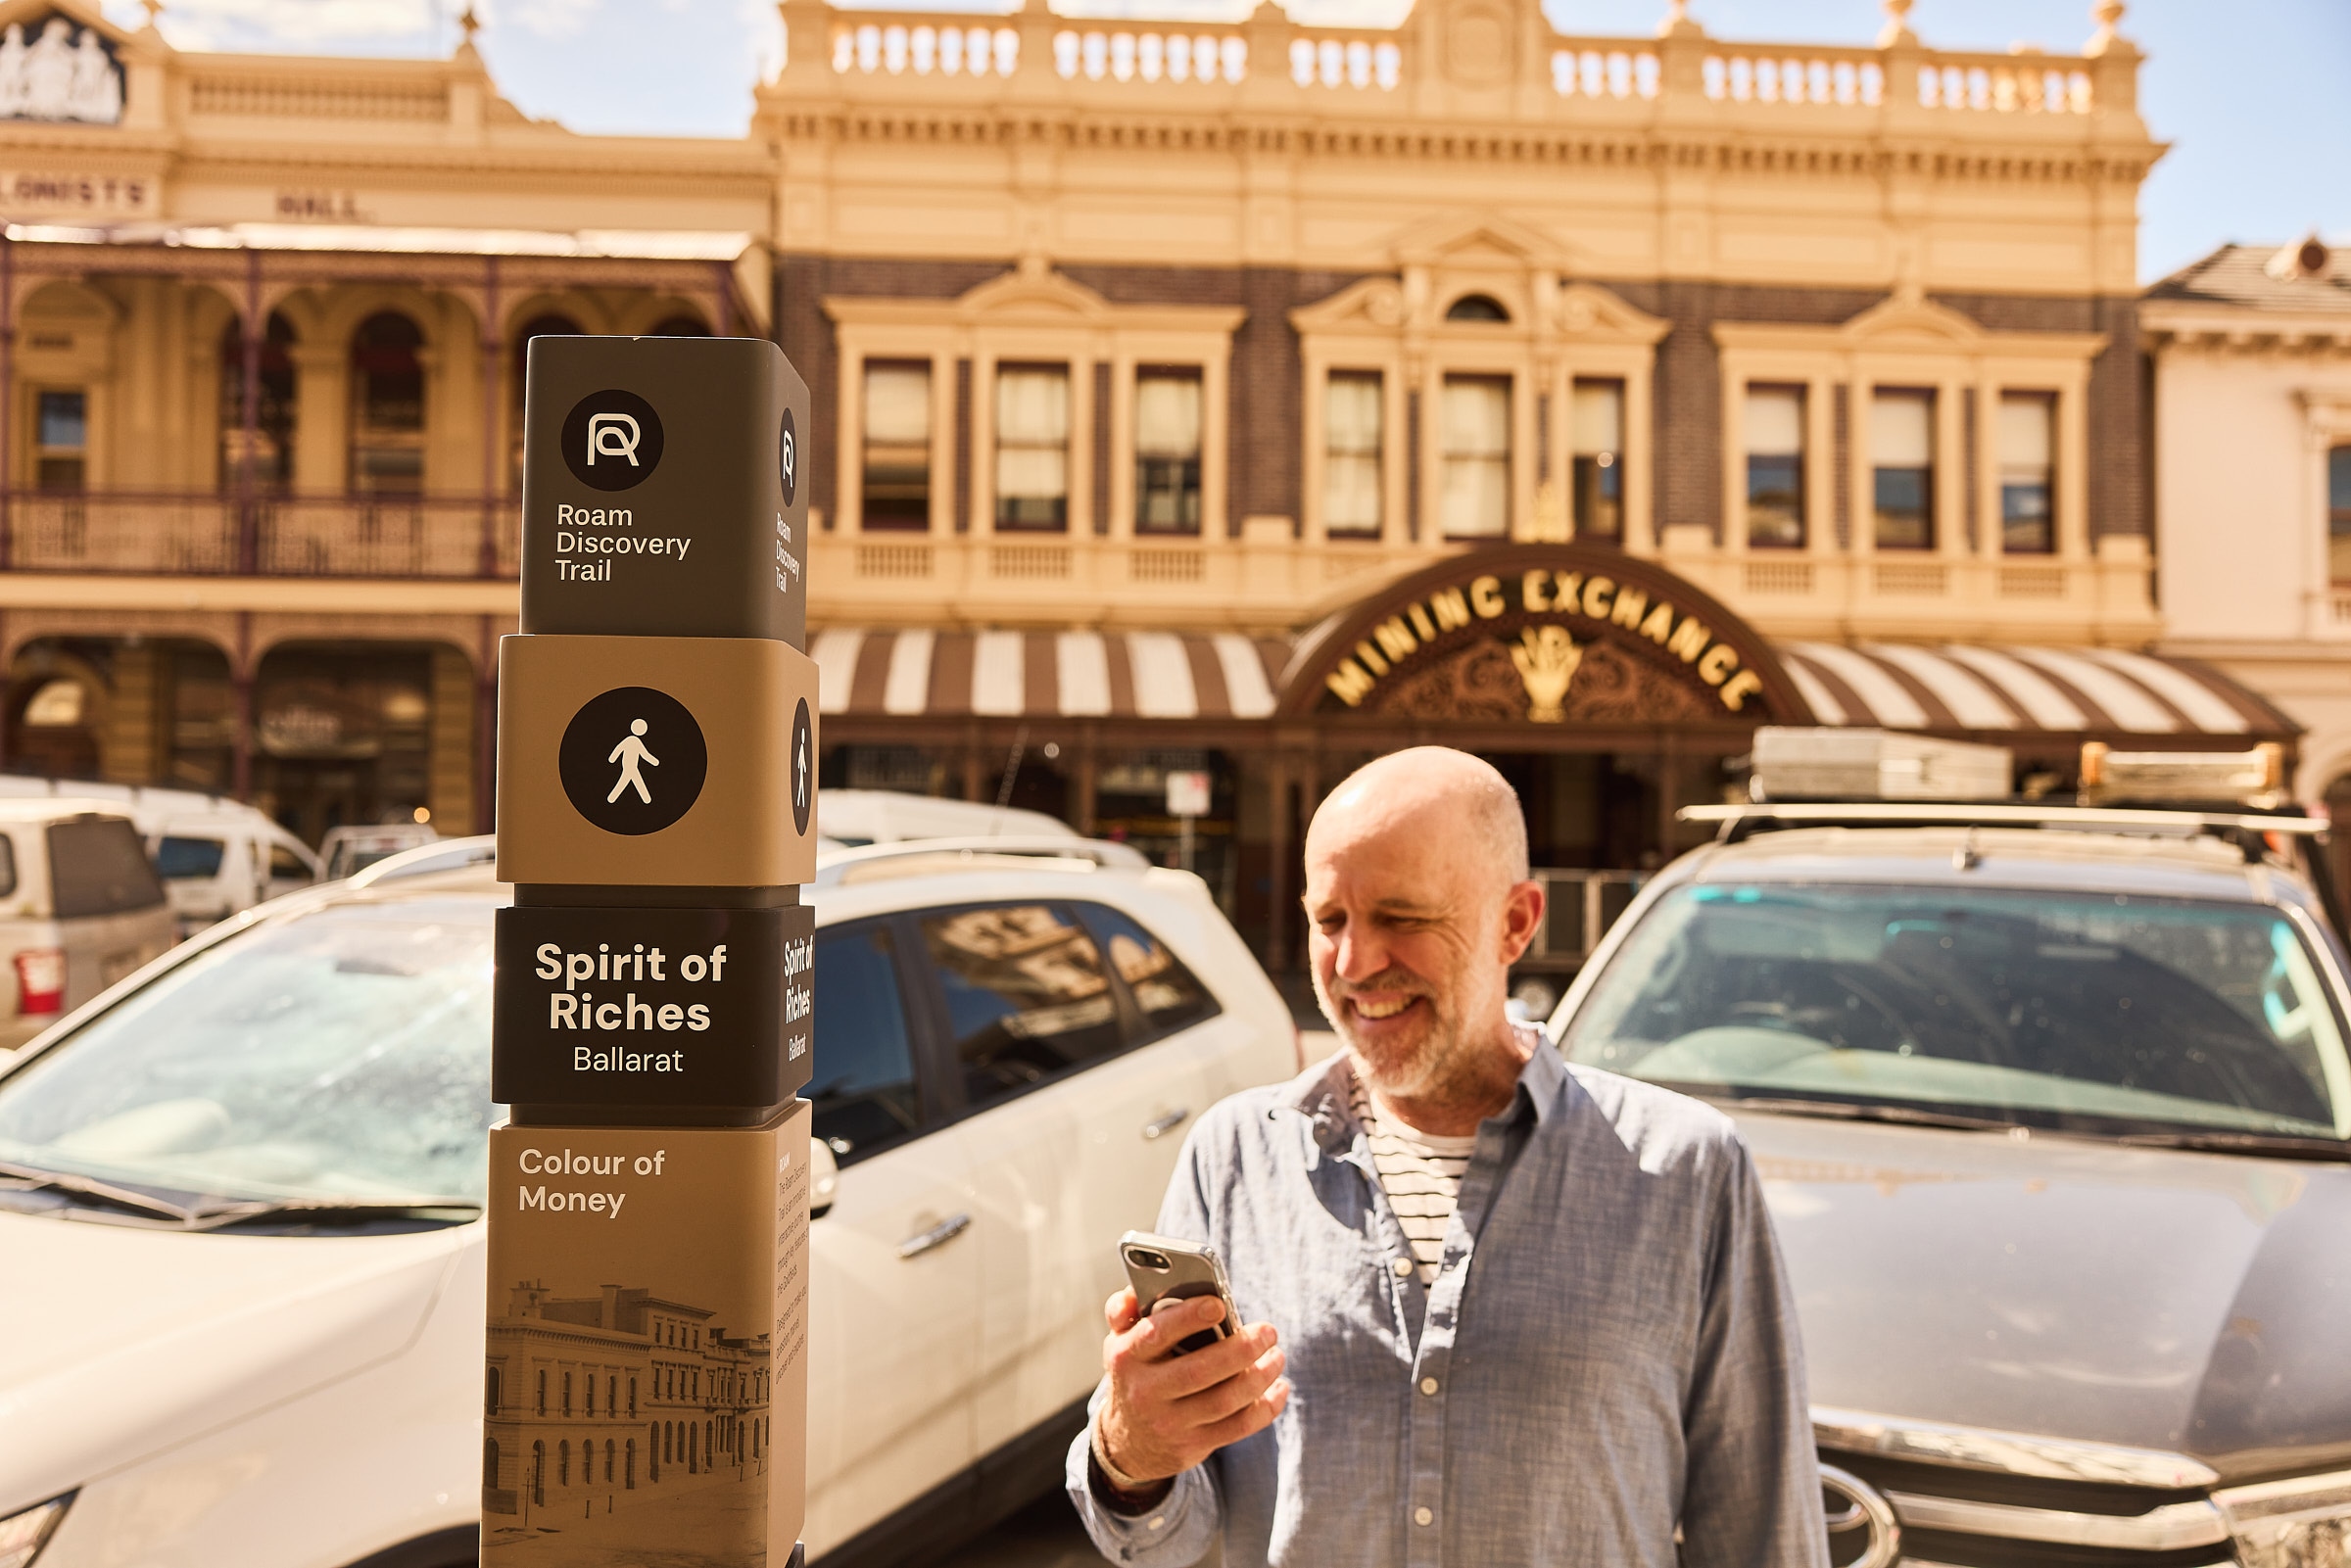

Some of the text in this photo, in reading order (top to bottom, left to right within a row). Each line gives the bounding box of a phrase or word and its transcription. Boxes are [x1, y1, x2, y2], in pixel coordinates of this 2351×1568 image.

[556, 503, 634, 527] Roam
[776, 511, 792, 544] Roam
[555, 531, 692, 561] Discovery
[776, 539, 800, 584] Discovery
[554, 558, 612, 582] Trail
[775, 565, 788, 594] Trail
[1325, 568, 1763, 712] MINING EXCHANGE
[535, 943, 728, 991] Spirit of
[784, 933, 814, 986] Spirit of
[550, 991, 712, 1031] Riches
[786, 983, 810, 1024] Riches
[574, 1046, 684, 1072] Ballarat
[789, 1032, 806, 1062] Ballarat
[518, 1148, 666, 1175] Colour of
[518, 1185, 627, 1219] Money
